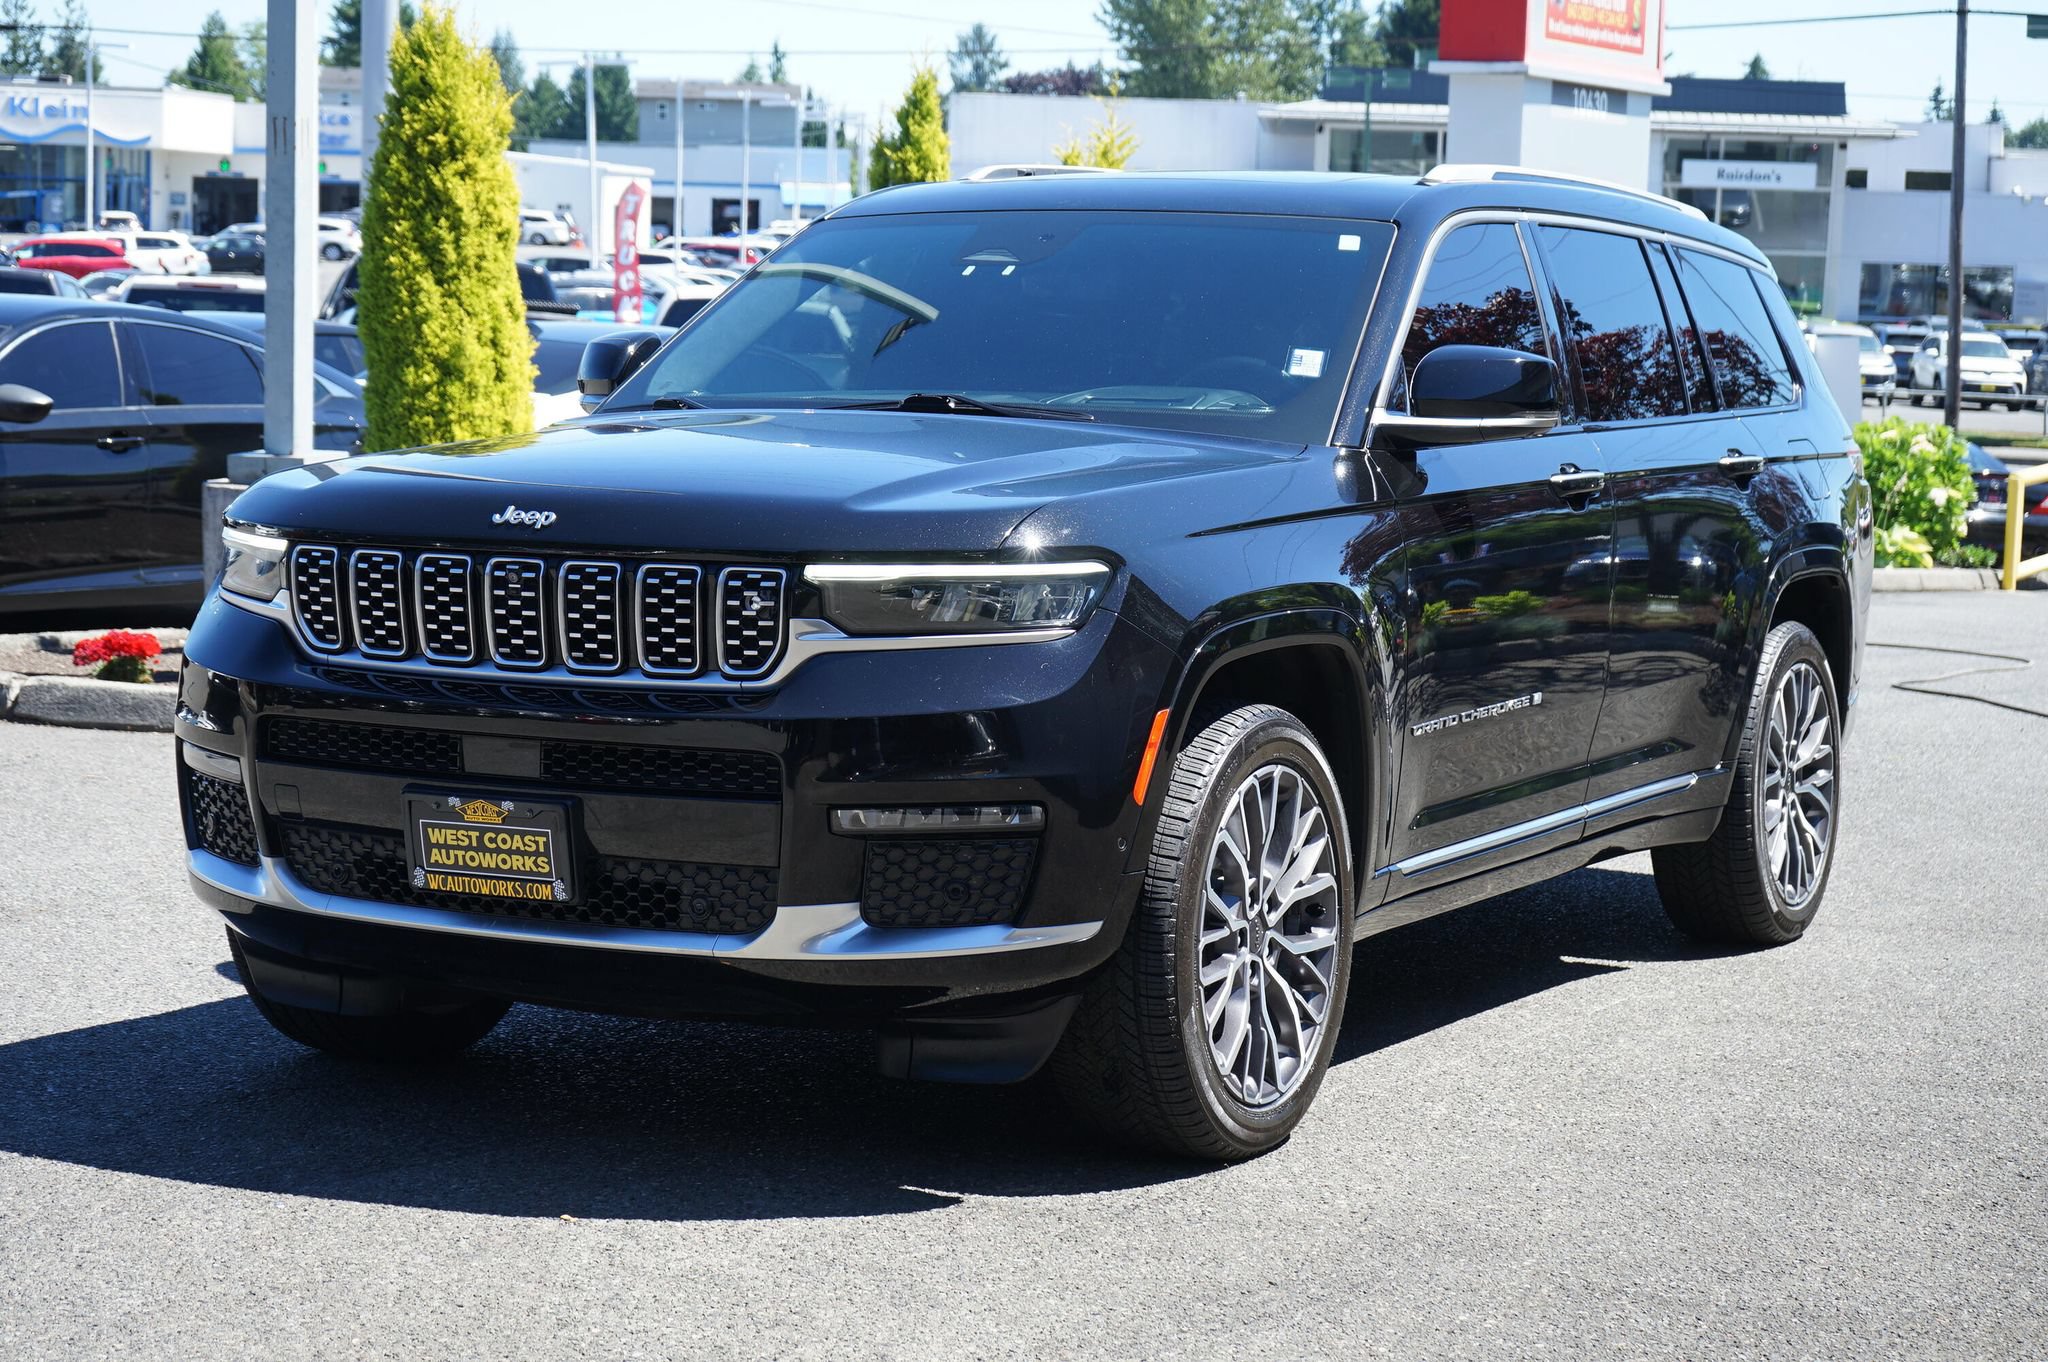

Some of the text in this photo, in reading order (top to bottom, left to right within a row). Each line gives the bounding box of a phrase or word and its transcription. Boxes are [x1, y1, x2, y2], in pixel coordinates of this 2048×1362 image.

[8, 95, 89, 118] Klein
[617, 193, 641, 322] TRUCK
[492, 505, 556, 529] Jeep
[1412, 714, 1459, 736] GRAND
[1461, 696, 1530, 723] CHEROKEE
[428, 828, 546, 852] WEST COAST
[430, 848, 550, 873] AUTOWORKS
[427, 873, 553, 900] WCAUTOWORKS.COM
